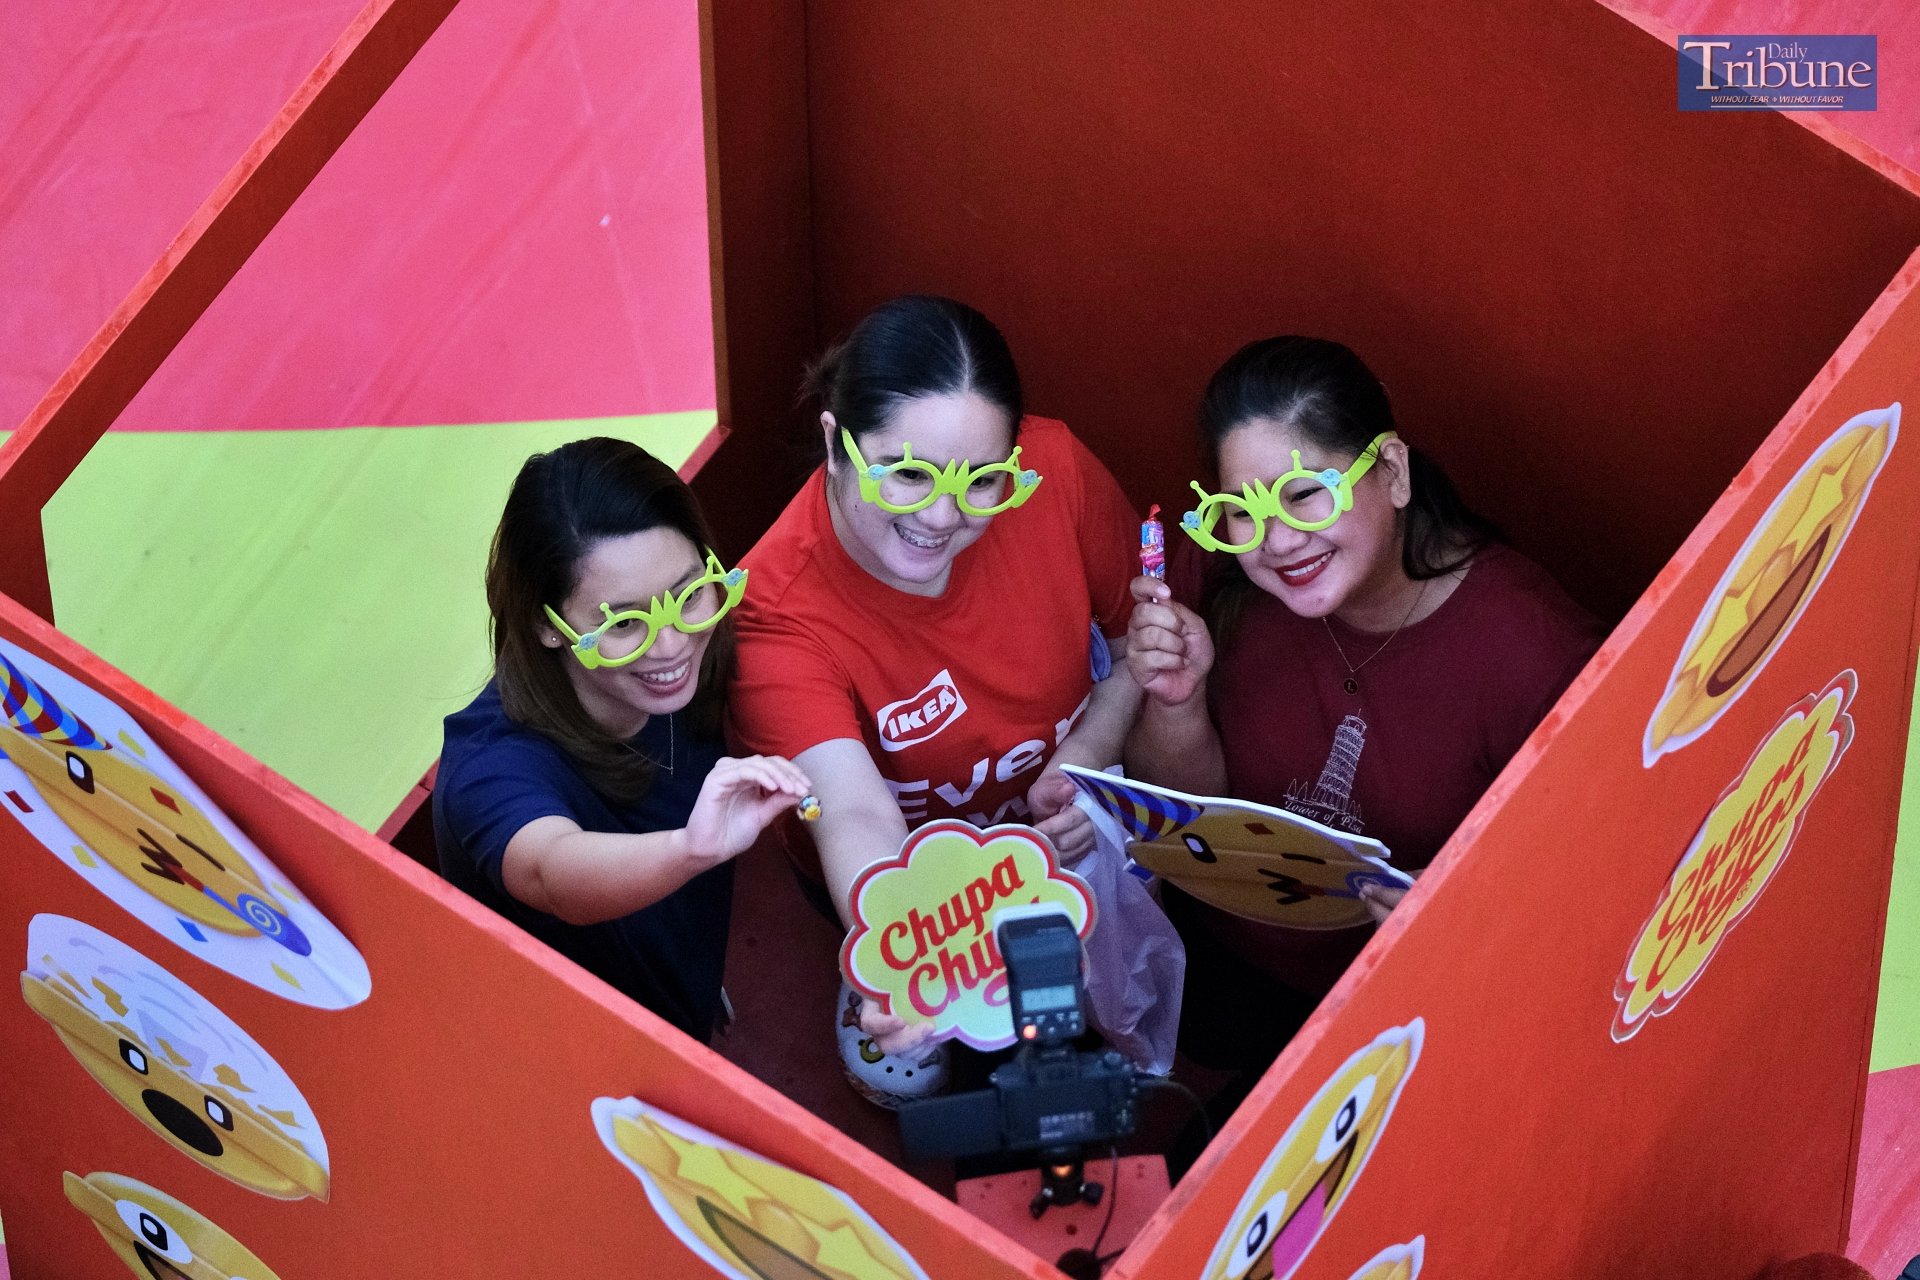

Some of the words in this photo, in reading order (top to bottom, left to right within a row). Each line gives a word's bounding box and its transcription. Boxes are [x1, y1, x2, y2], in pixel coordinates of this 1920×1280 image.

[887, 688, 957, 740] IKEA
[1285, 800, 1320, 819] Tower
[1323, 811, 1336, 825] of
[1340, 816, 1362, 834] Pisa
[1657, 717, 1820, 942] Chupa
[879, 853, 1026, 972] Chupa
[1646, 764, 1809, 992] Chups
[907, 900, 1035, 1017] Chu
